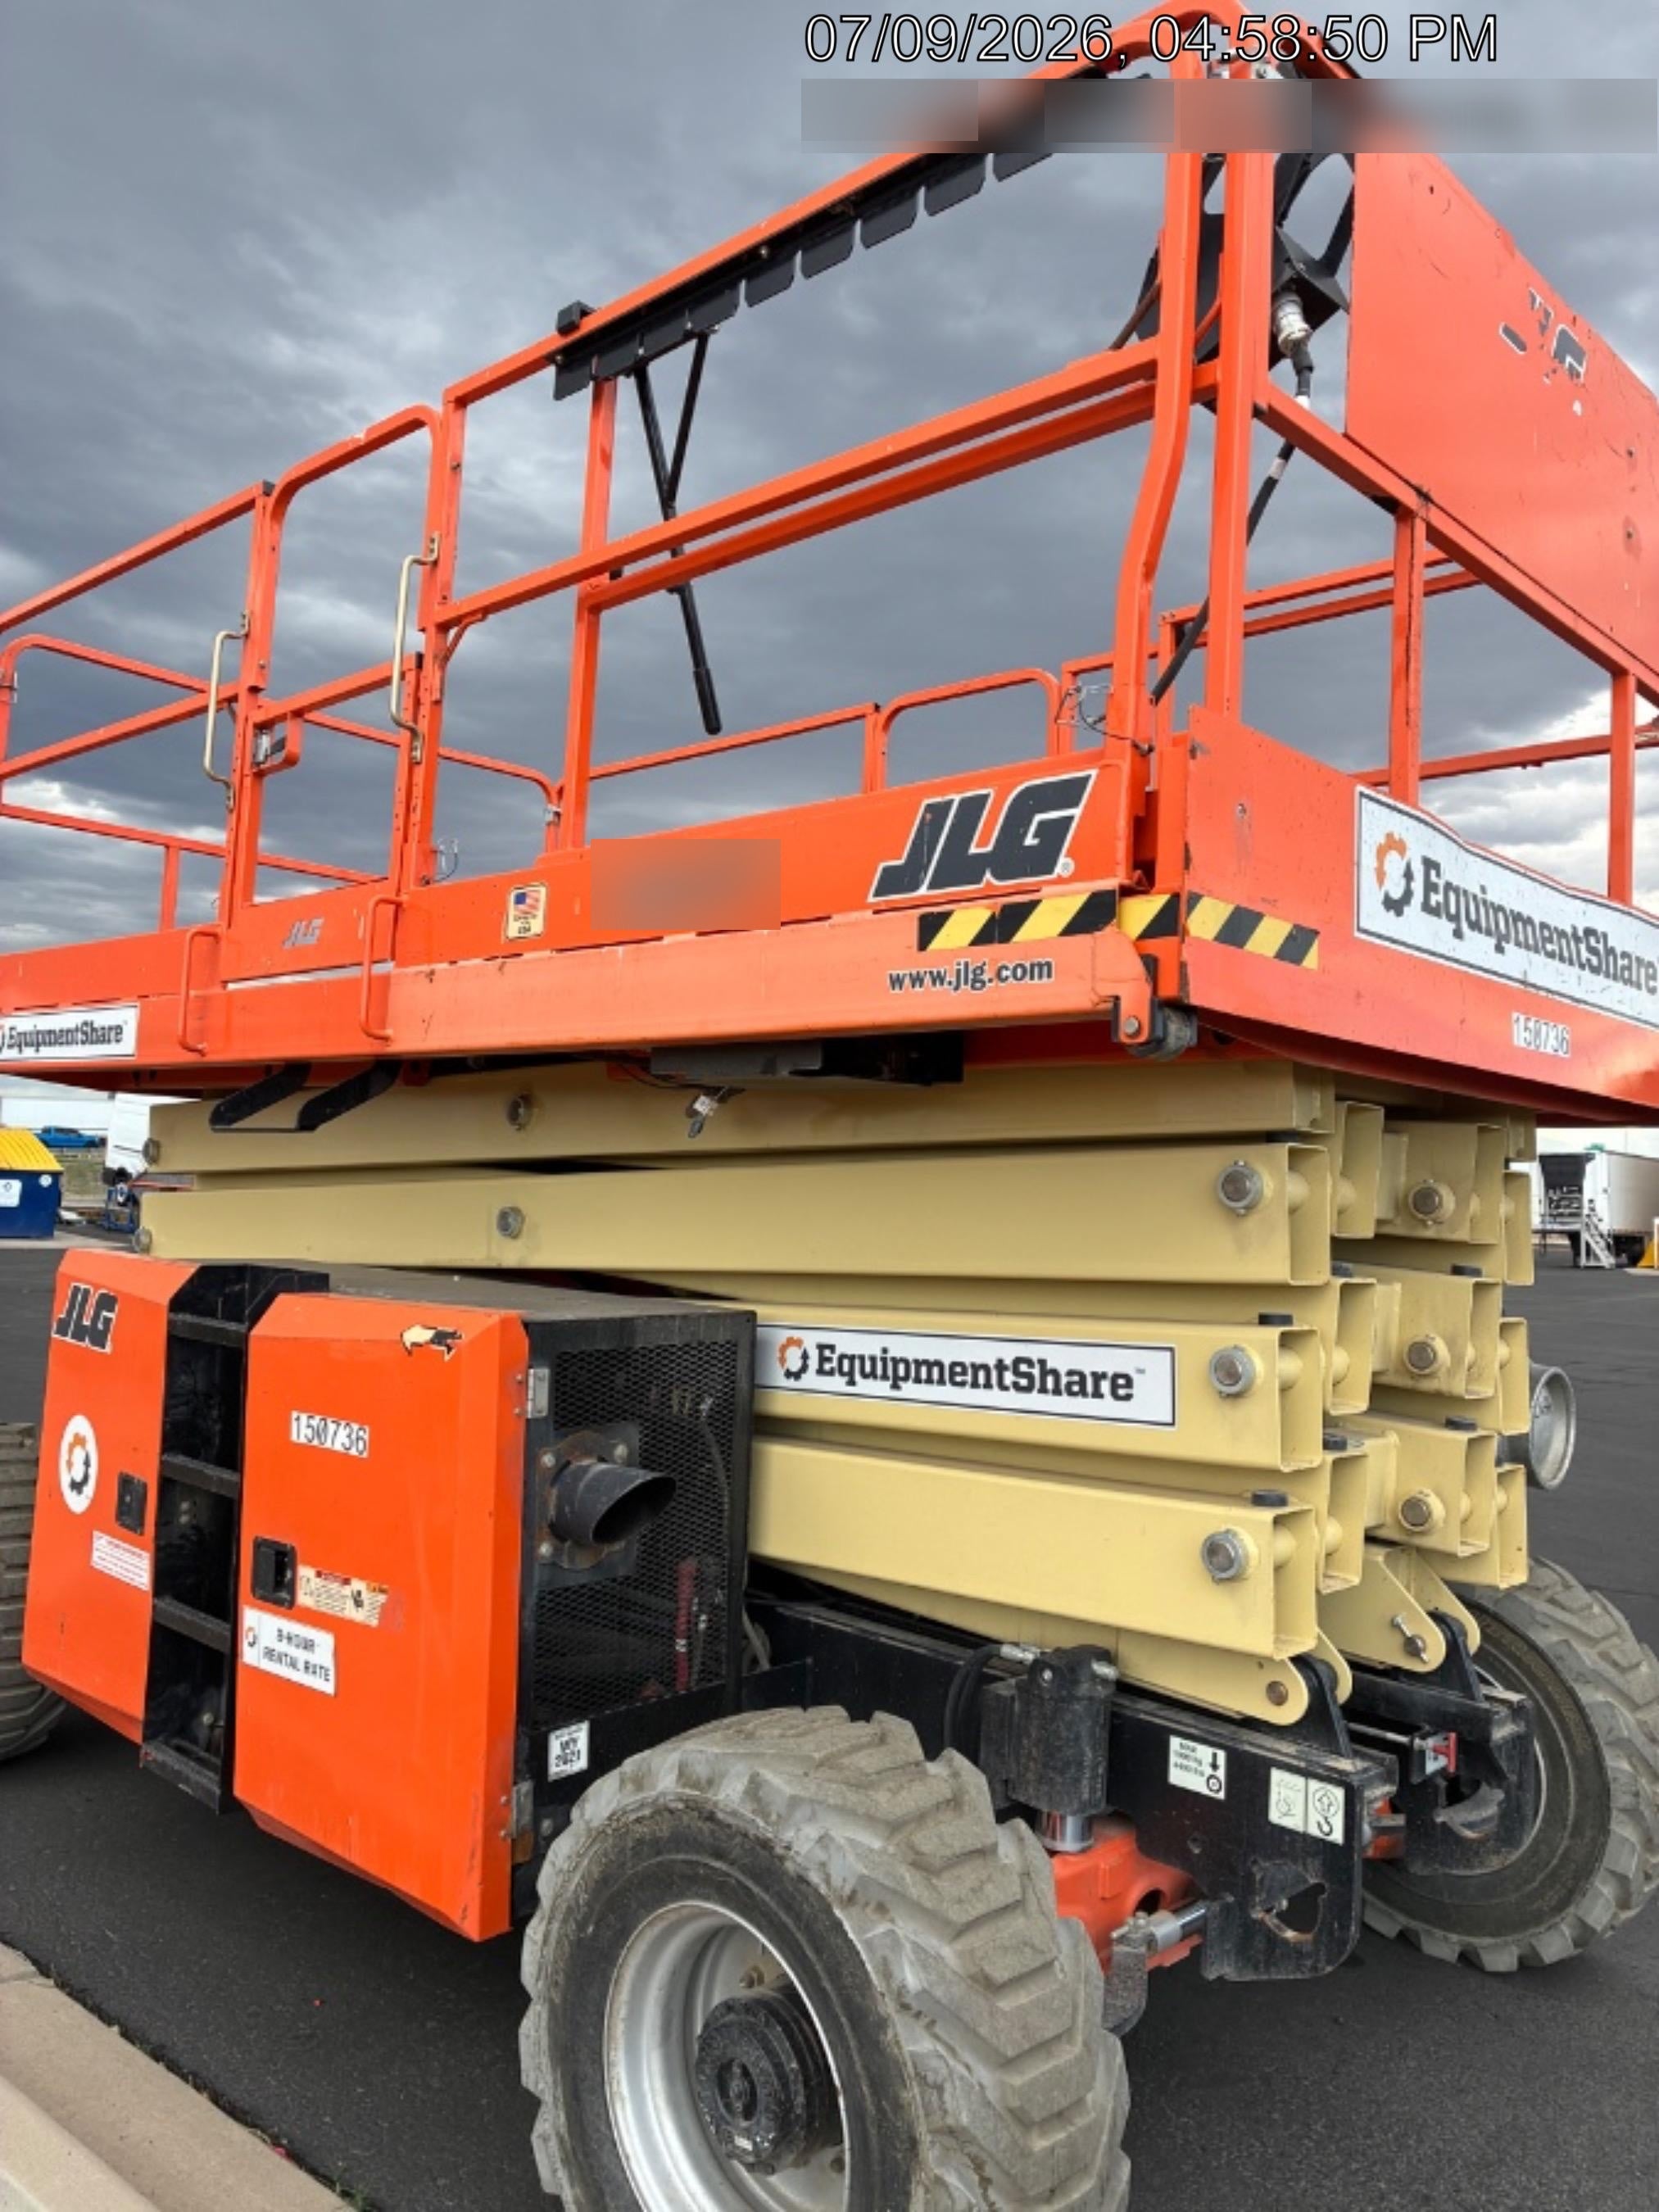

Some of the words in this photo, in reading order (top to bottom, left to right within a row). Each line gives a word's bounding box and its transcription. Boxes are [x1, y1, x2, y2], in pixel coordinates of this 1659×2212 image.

[868, 769, 1097, 901] JLG
[1420, 854, 1658, 996] EquipmentShare
[888, 960, 1054, 991] www.jlg.com
[7, 1019, 124, 1054] EquipmentShare
[1513, 1014, 1570, 1055] 150736
[52, 1282, 119, 1353] JLG
[815, 1343, 1134, 1403] EquipmentShare
[294, 1414, 368, 1456] 150736
[263, 1645, 301, 1672] RENTAL
[303, 1660, 331, 1682] RATE
